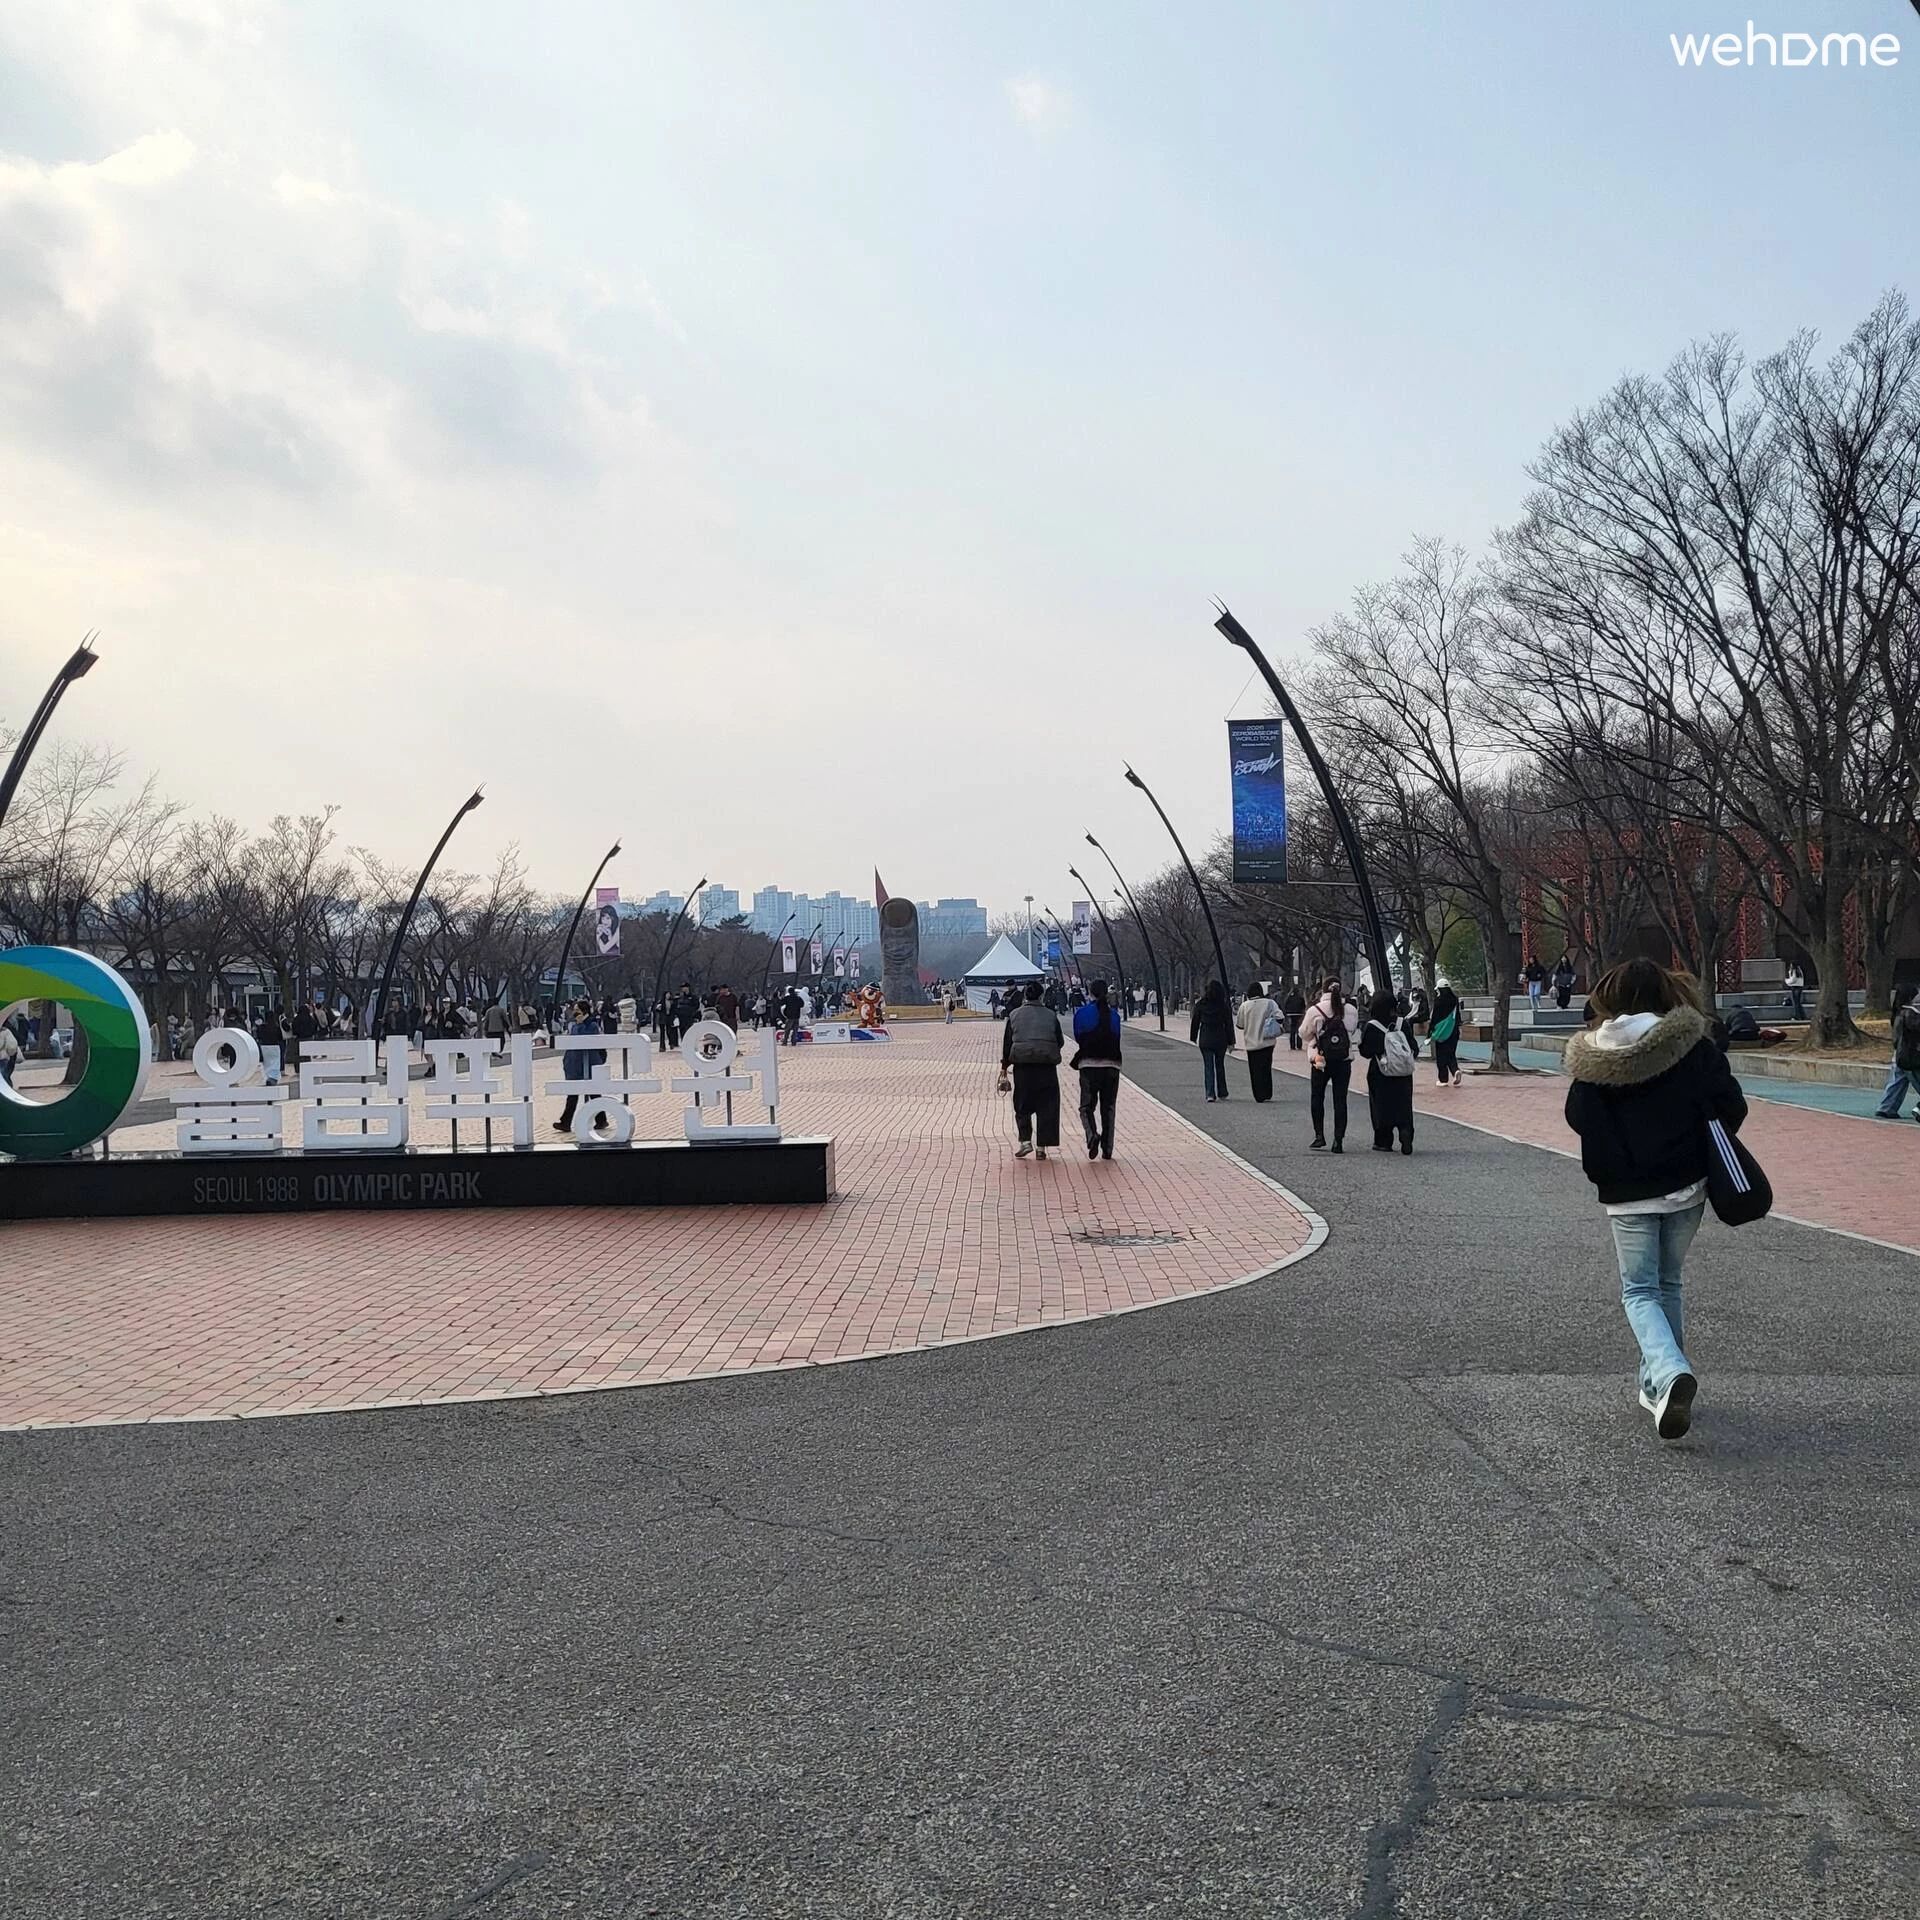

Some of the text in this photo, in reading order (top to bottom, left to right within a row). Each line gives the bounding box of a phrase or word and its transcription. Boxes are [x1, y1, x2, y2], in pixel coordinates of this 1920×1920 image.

[168, 1019, 782, 1153] 올림픽공원
[193, 1170, 482, 1204] SEOUL 1988 OLYMPIC PARK
